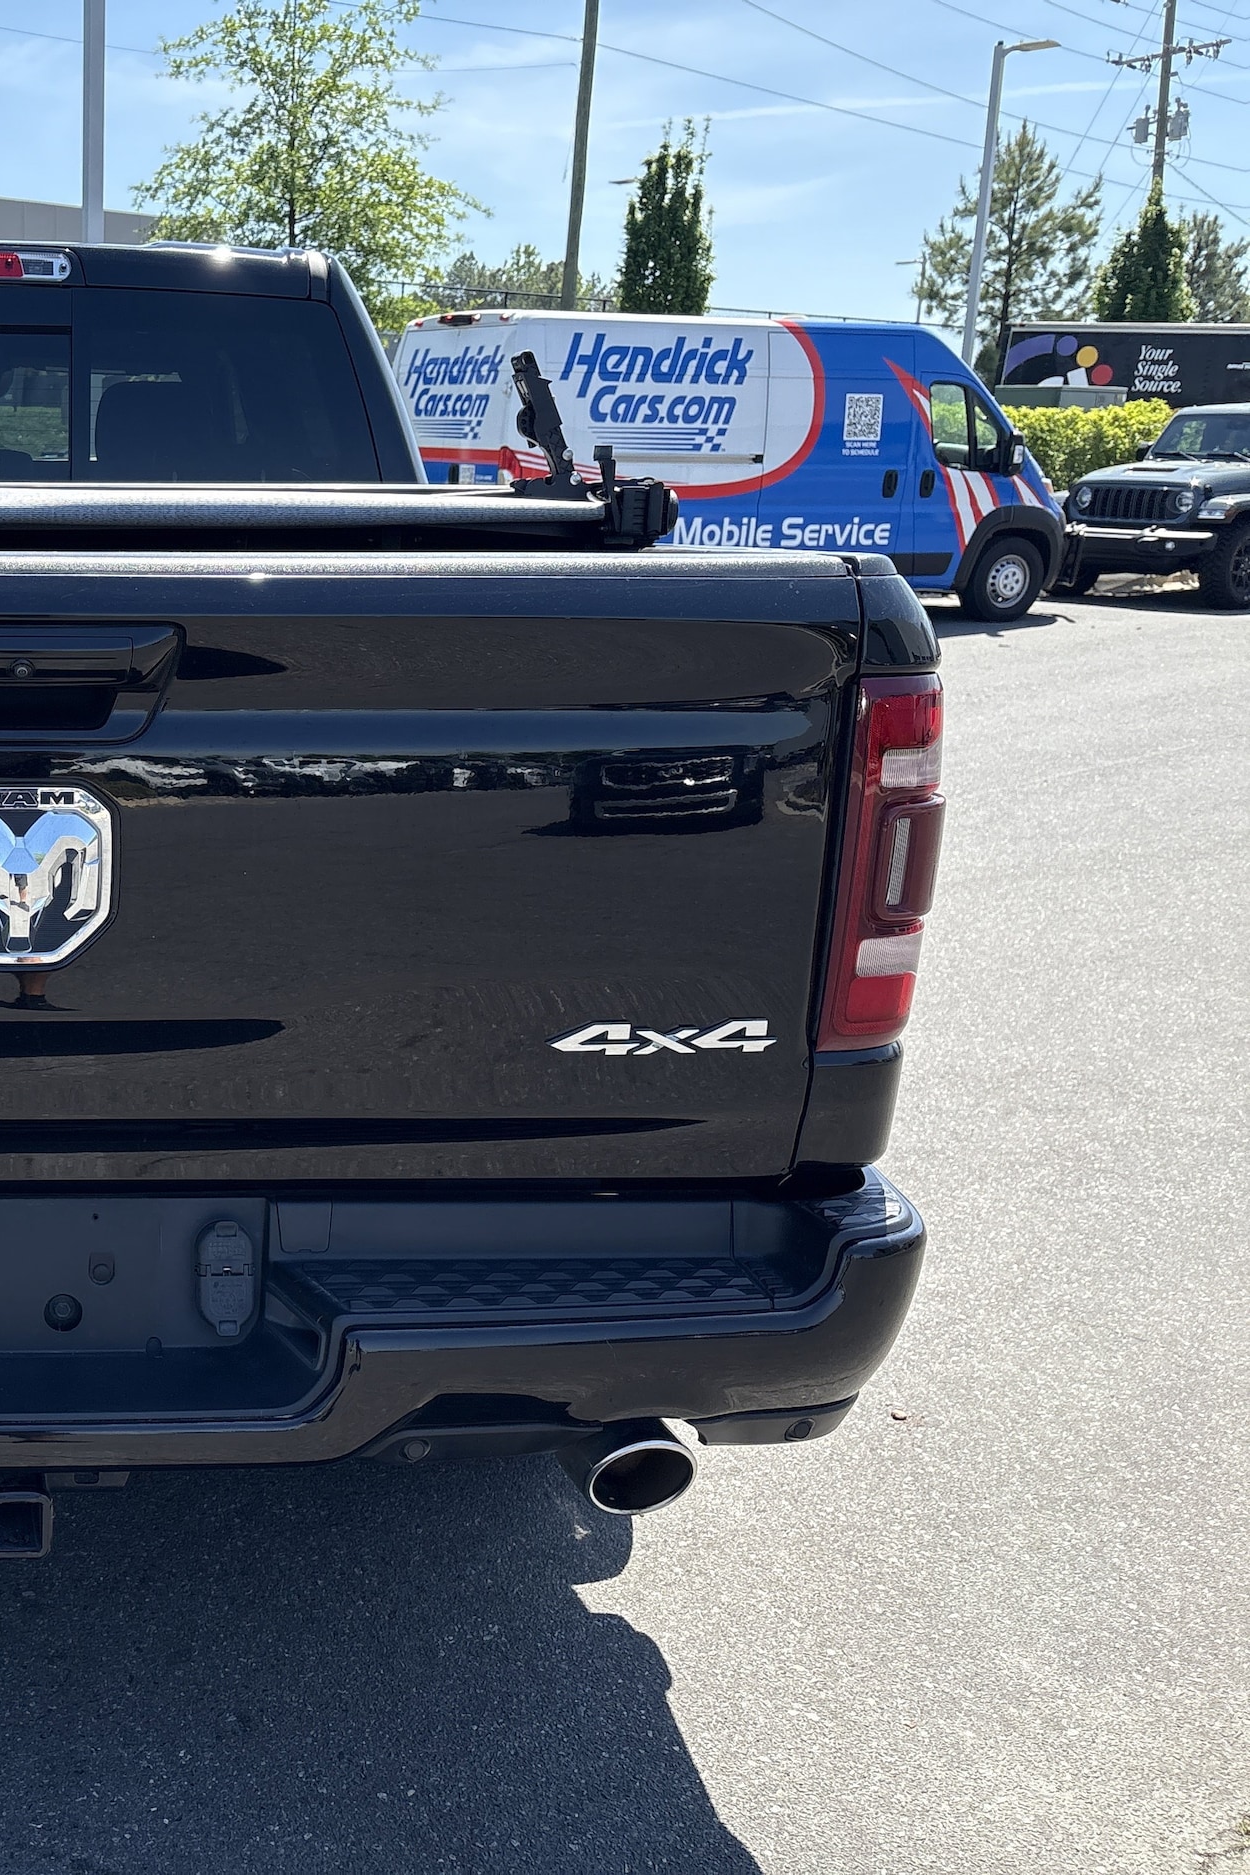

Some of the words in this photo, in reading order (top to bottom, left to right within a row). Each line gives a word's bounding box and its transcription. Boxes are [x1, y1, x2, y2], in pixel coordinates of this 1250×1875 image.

[559, 332, 754, 398] Hendrick
[1139, 345, 1174, 361] Your
[404, 345, 504, 399] Hendrick
[1131, 377, 1182, 393] Source.
[1134, 361, 1179, 381] Single
[414, 387, 490, 417] Cars.com
[589, 385, 737, 425] Cars.com
[674, 516, 773, 547] Mobile
[780, 516, 891, 546] Service
